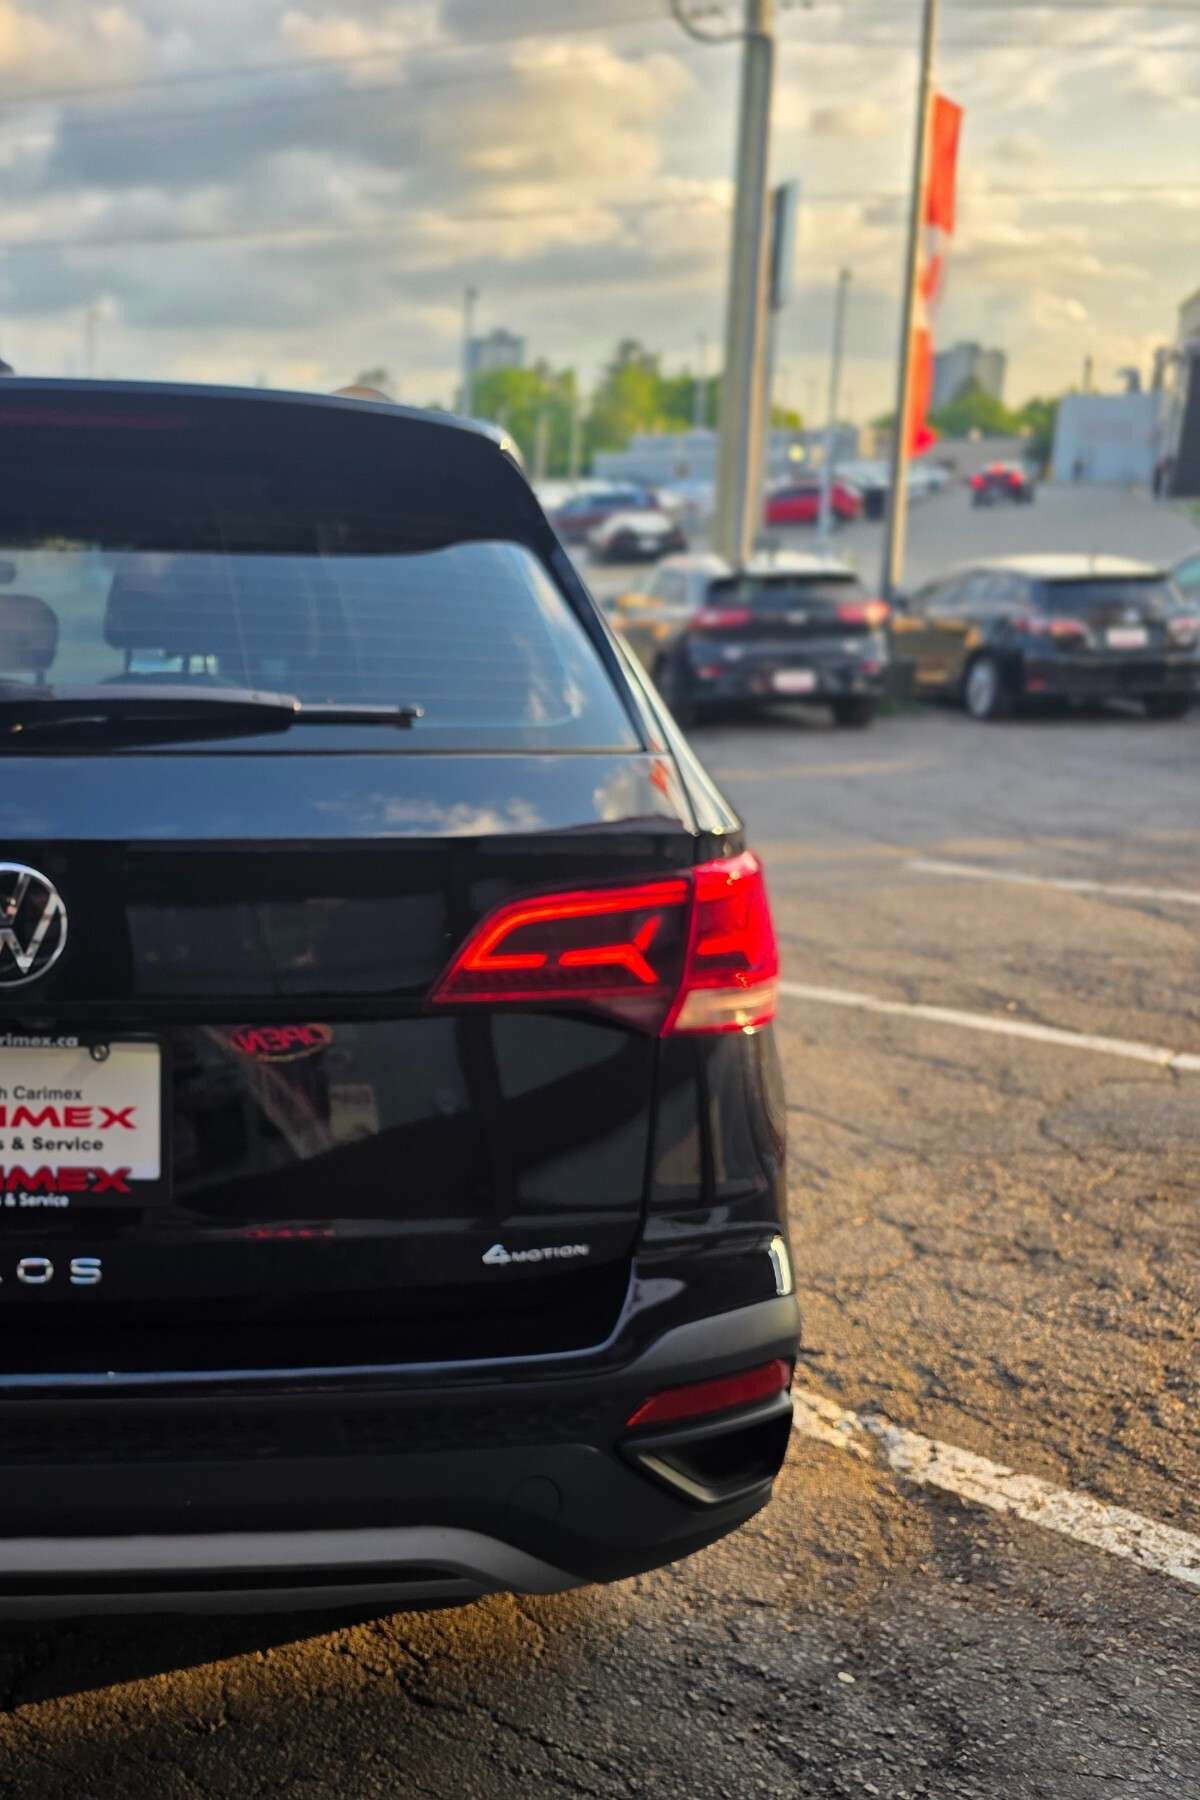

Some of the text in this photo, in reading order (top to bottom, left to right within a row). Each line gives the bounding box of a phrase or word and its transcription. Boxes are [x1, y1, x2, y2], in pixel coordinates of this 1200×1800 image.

[13, 1086, 82, 1100] Carimex
[12, 1137, 25, 1151] &
[32, 1137, 104, 1151] Service
[5, 1192, 17, 1206] &
[19, 1192, 70, 1207] Service
